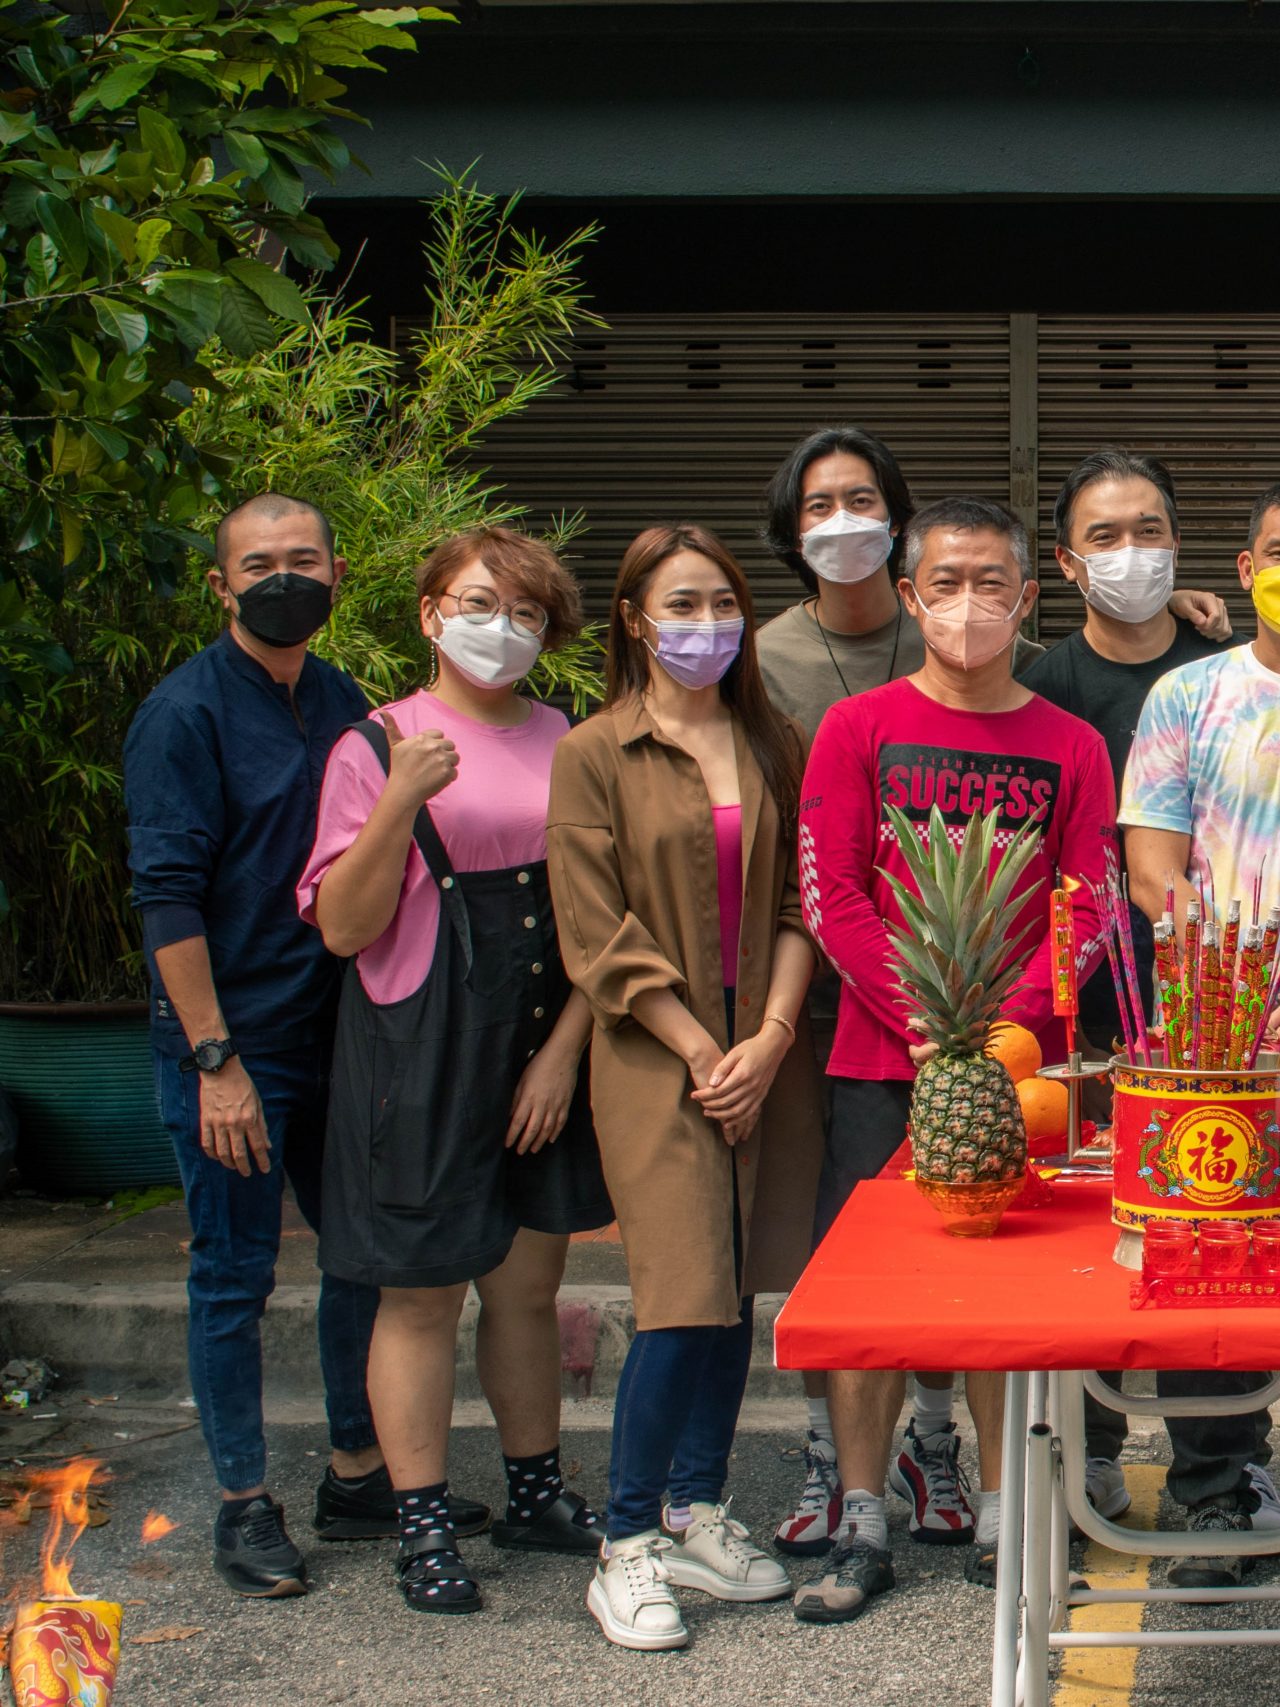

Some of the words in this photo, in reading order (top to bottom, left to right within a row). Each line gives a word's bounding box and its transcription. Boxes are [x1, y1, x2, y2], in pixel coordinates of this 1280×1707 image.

[886, 764, 1052, 822] SUCCESS
[918, 754, 976, 769] FIGHT
[993, 763, 1026, 775] FOR
[1187, 1126, 1238, 1185] 福
